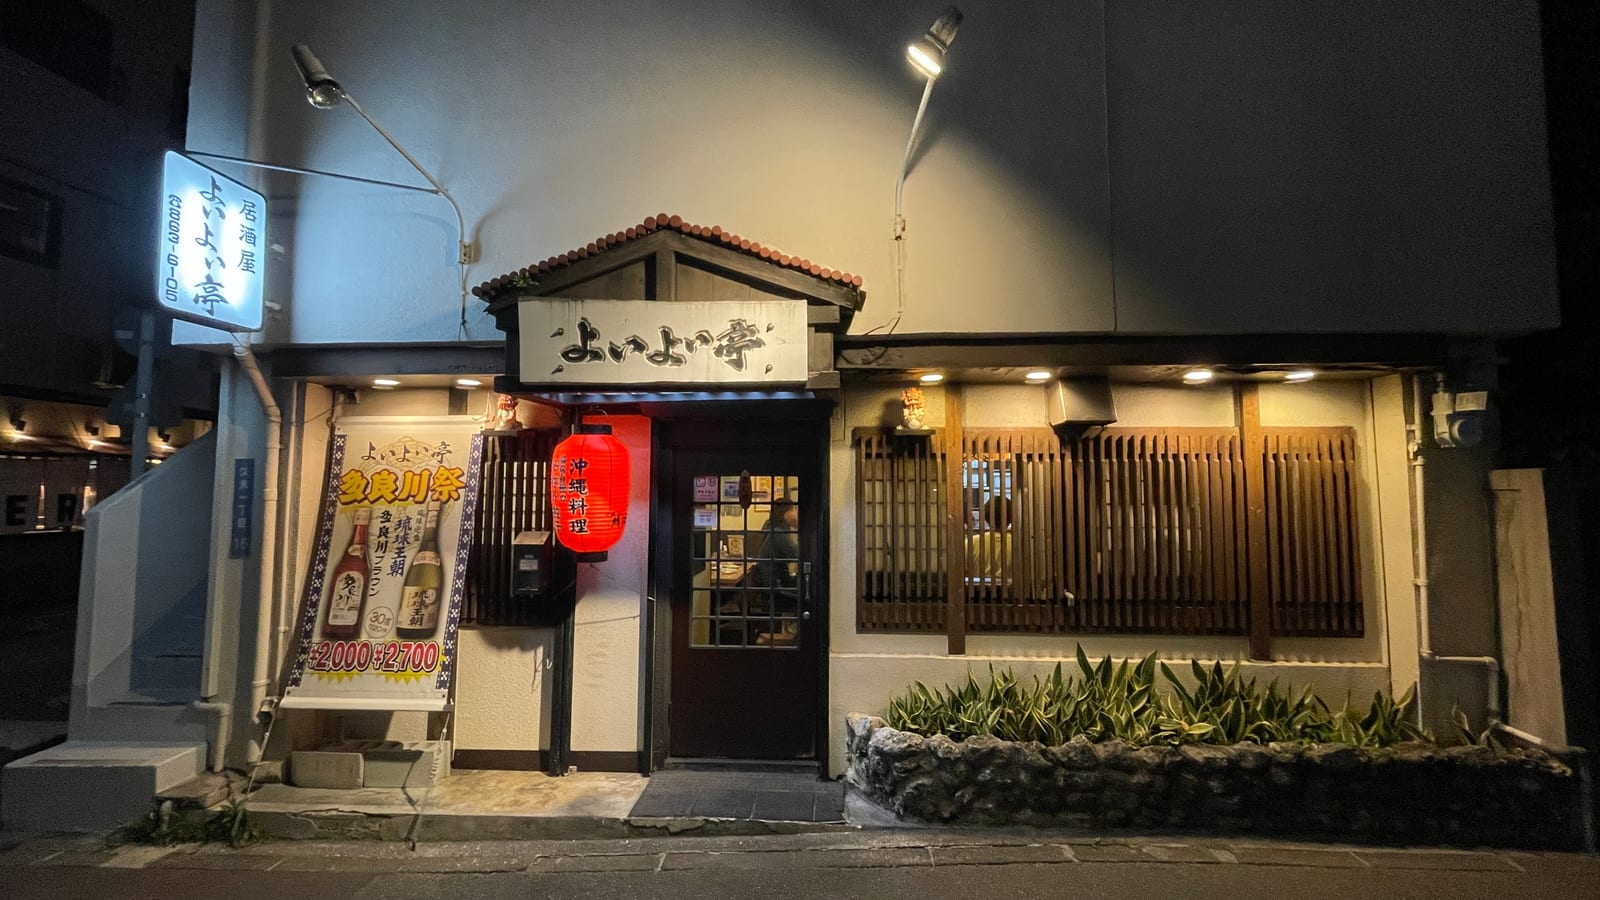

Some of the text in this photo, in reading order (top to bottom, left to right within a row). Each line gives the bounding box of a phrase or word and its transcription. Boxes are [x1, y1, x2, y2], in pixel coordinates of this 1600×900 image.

[193, 175, 229, 316] よいよい亭
[238, 200, 257, 274] 居酒屋
[560, 316, 767, 372] よいよい亭
[361, 441, 453, 464] よいよい亭
[337, 465, 466, 505] 多良川祭
[568, 457, 590, 534] 沖縄料理
[387, 515, 412, 577] 琉球王朝
[308, 640, 439, 672] ¥2,000 ¥2,700
